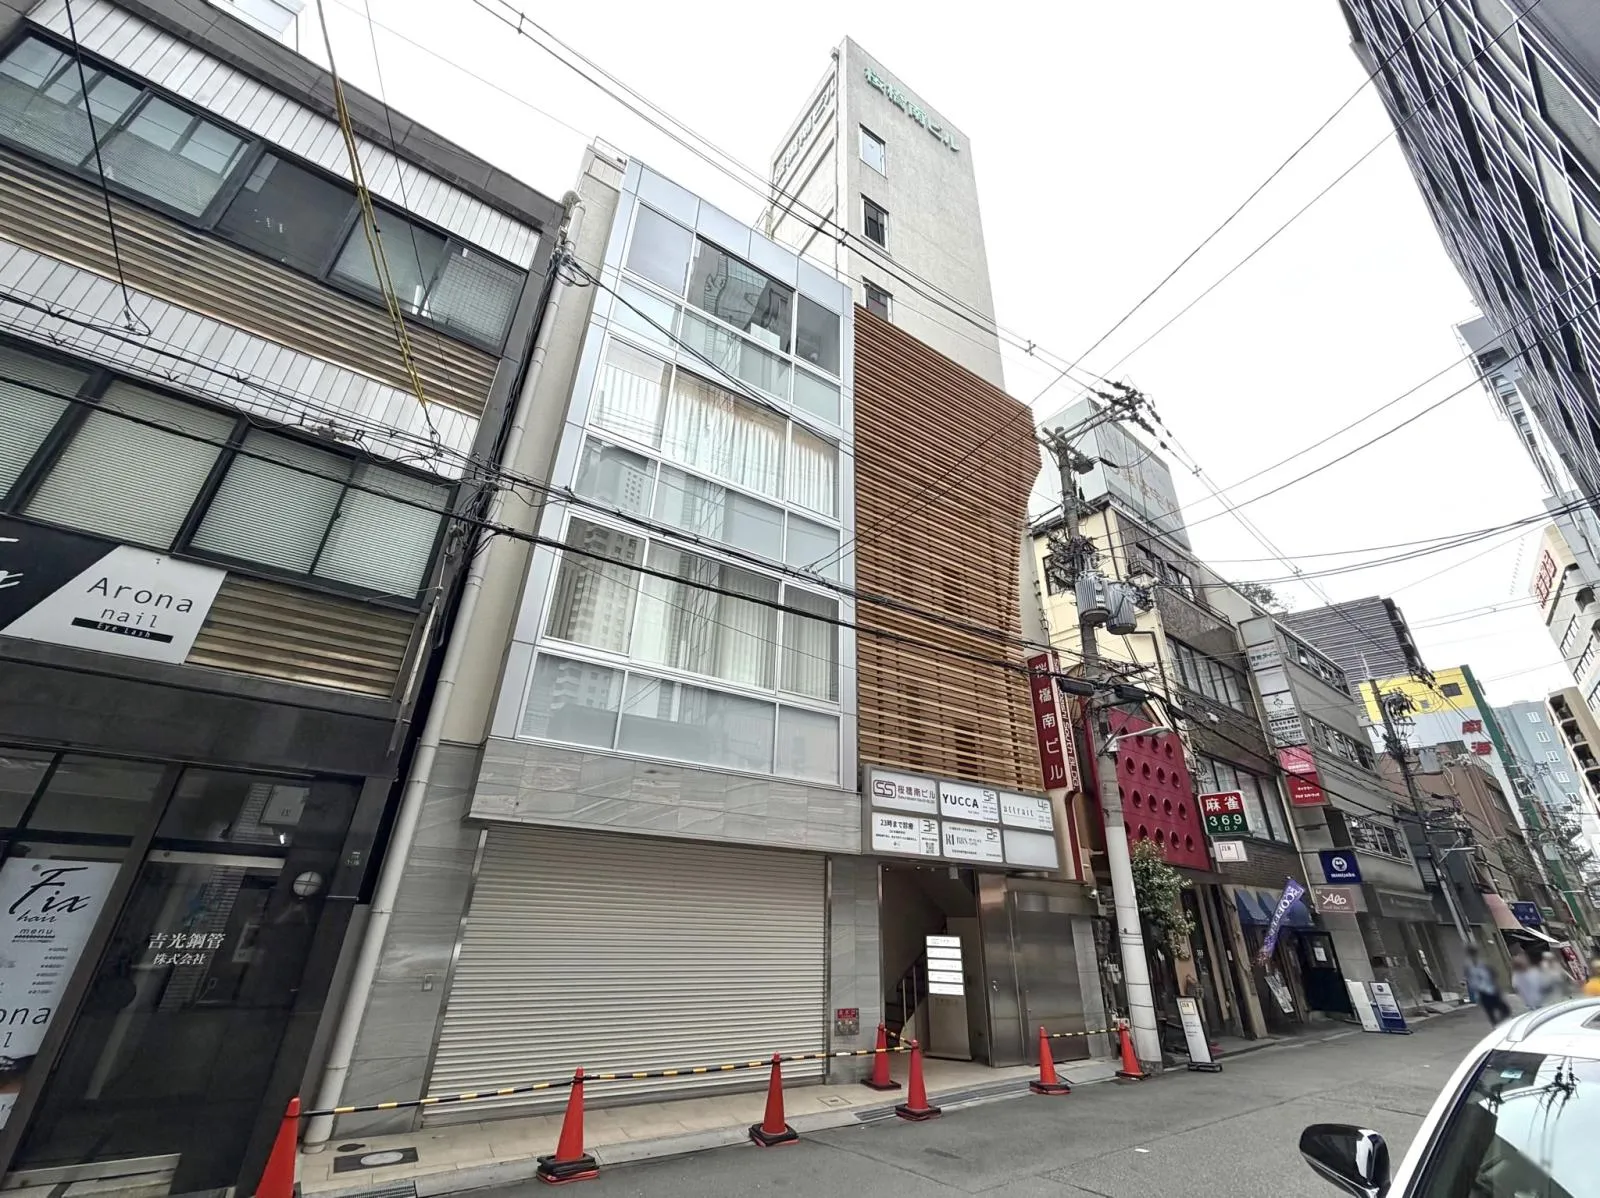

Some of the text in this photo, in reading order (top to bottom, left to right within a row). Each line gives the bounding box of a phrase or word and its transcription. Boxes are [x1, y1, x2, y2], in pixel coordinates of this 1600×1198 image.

[87, 577, 194, 614] Arona
[100, 607, 157, 629] nail
[942, 793, 979, 809] YUCCA
[1205, 795, 1240, 812] 麻雀
[1209, 814, 1242, 827] 369
[8, 867, 91, 915] Fix
[17, 909, 57, 923] hair
[148, 932, 226, 949] 吉光鋼管
[153, 953, 206, 965] 株式会社
